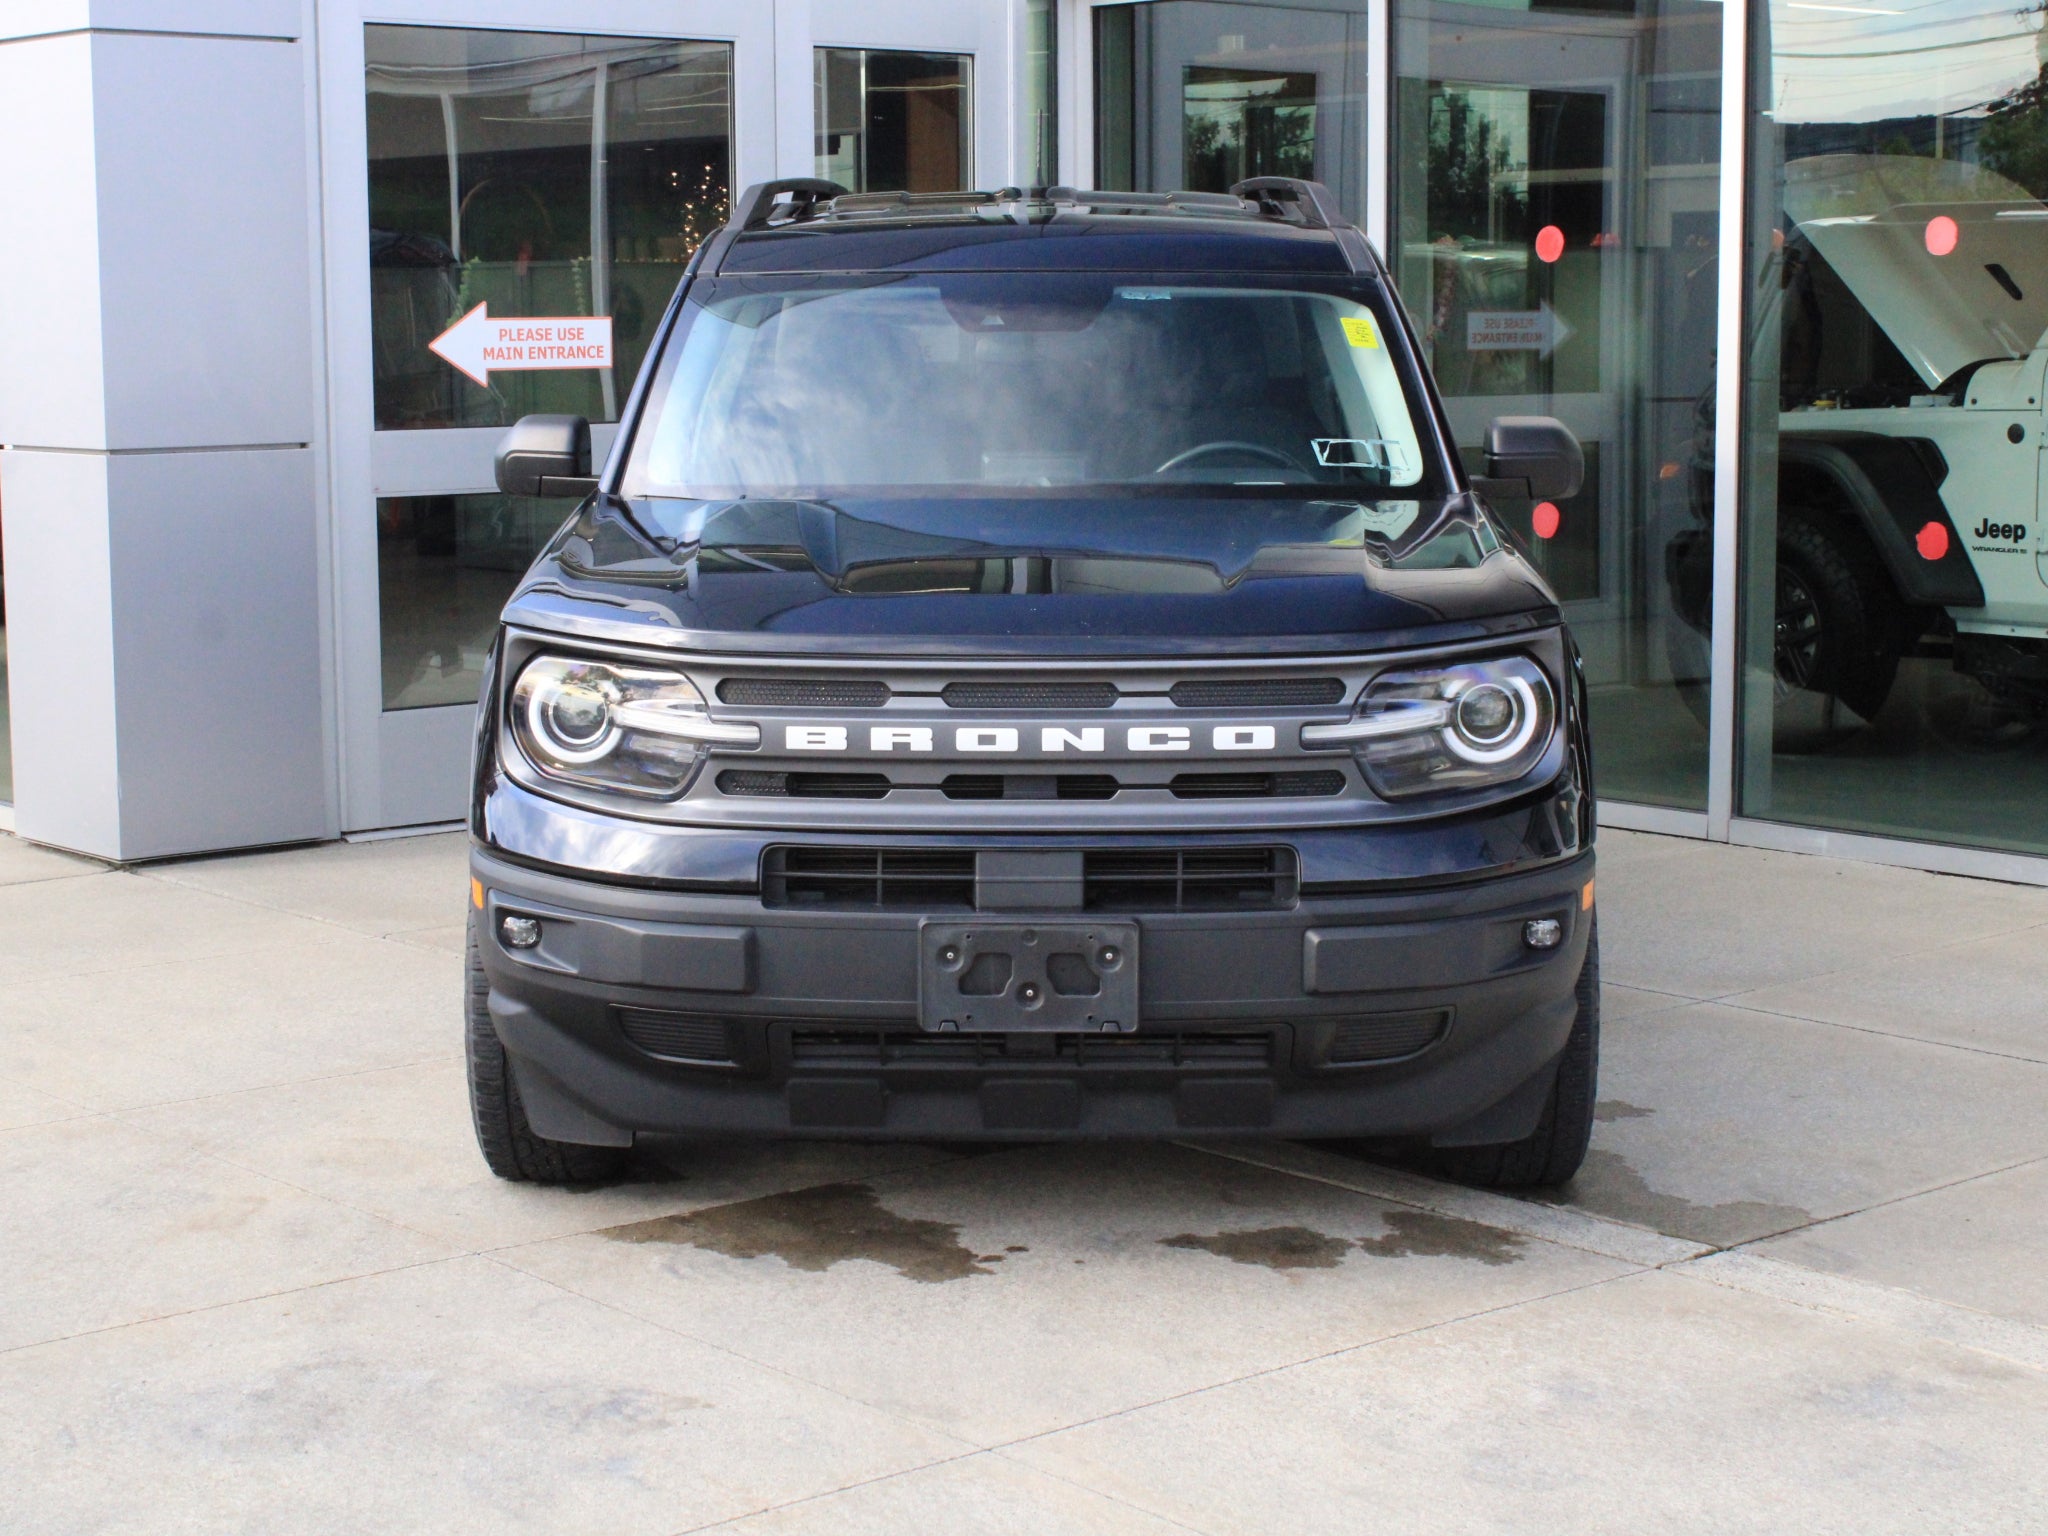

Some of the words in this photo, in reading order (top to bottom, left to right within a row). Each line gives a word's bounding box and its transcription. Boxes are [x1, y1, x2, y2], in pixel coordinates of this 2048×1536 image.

[499, 328, 552, 342] PLEASE
[557, 327, 585, 341] USE
[483, 346, 523, 360] MAIN
[528, 345, 604, 360] ENTRANCE
[1974, 518, 2026, 543] Jeep
[1972, 546, 2018, 554] WRANGLER
[785, 726, 1276, 752] BRONCO
